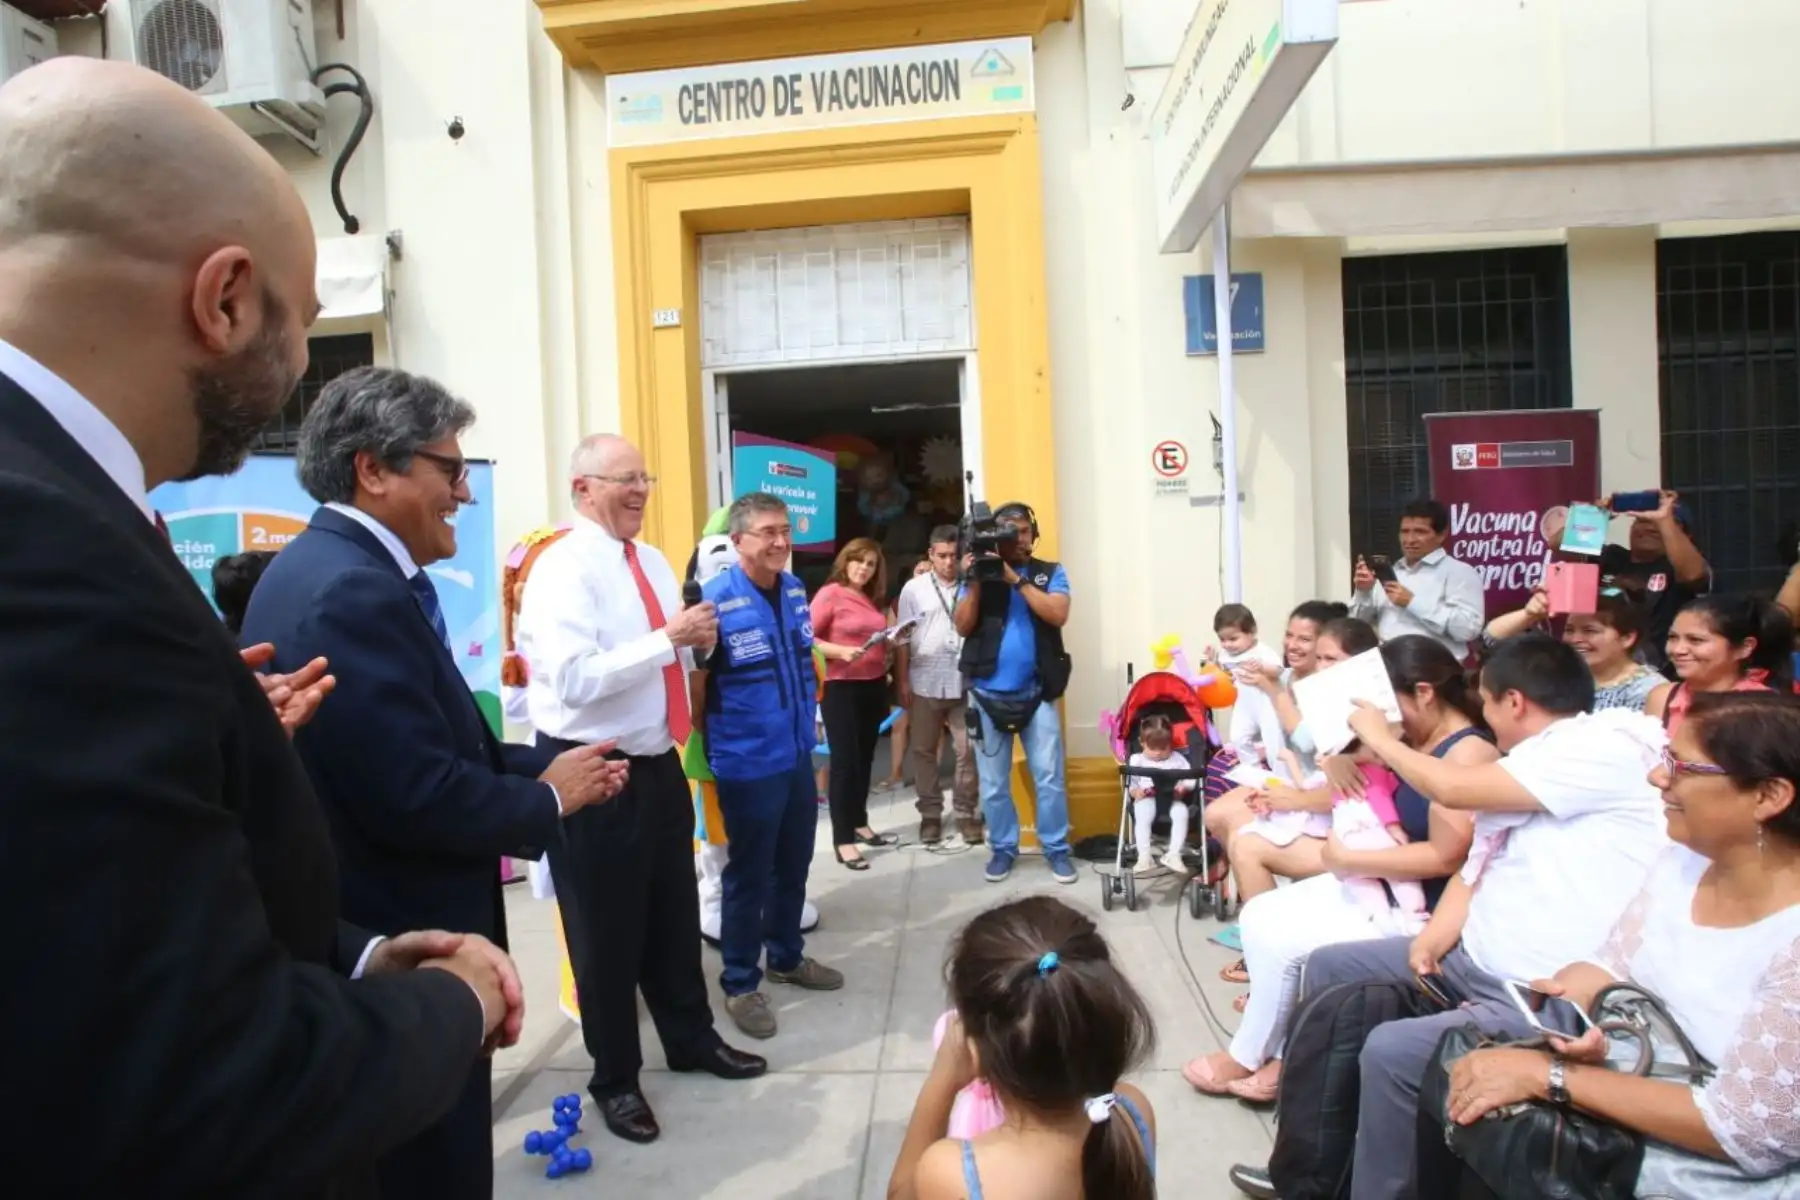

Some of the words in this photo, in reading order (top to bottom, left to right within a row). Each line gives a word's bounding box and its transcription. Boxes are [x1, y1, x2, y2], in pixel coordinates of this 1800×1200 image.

[678, 79, 766, 125] CENTRO
[773, 75, 804, 117] DE
[810, 58, 961, 113] VACUNACION
[1201, 33, 1257, 146] INTERNACIONAL
[1203, 329, 1262, 340] Vaación
[761, 480, 772, 494] La
[773, 484, 805, 498] varicela
[1450, 503, 1537, 535] Vacuna
[174, 540, 216, 553] cién
[251, 526, 267, 544] 2
[1453, 534, 1523, 561] contra
[1525, 533, 1544, 556] la
[1474, 549, 1552, 591] aricel
